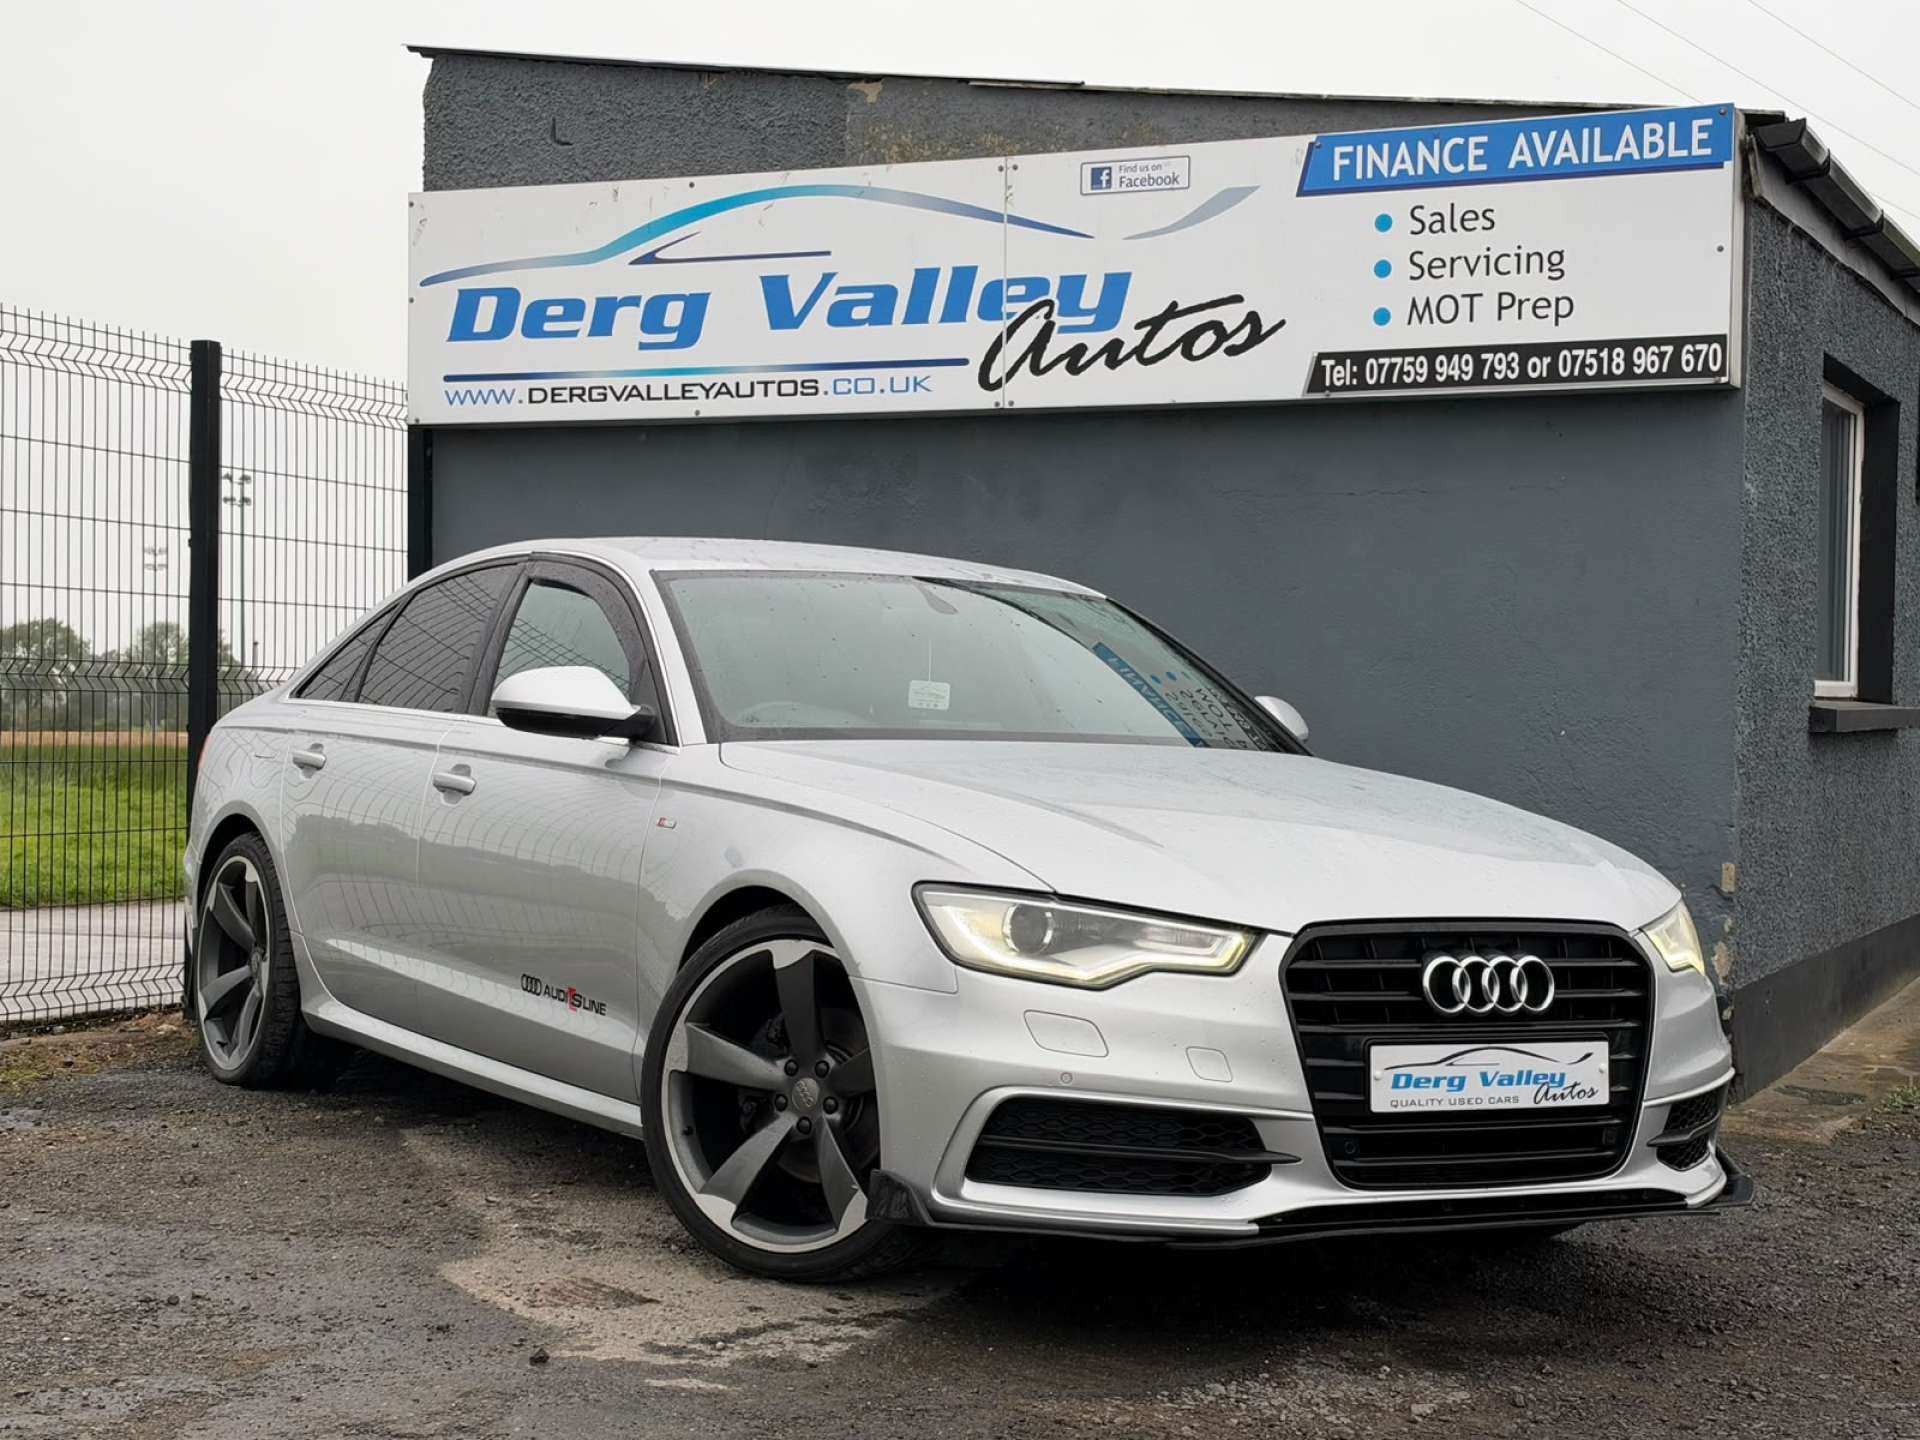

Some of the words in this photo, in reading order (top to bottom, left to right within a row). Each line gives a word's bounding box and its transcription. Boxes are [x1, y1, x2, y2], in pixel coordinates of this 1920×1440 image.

[1333, 136, 1488, 181] FINANCE
[1508, 119, 1713, 169] AVAILABLE
[1119, 165, 1137, 173] Find
[1152, 163, 1162, 171] on
[1119, 172, 1179, 187] Facebook
[1409, 203, 1495, 235] Sales
[1409, 245, 1565, 281] Servicing
[446, 286, 711, 351] Derg
[759, 265, 1132, 335] Valley
[1407, 293, 1483, 326] MOT
[1498, 291, 1574, 326] Prep
[978, 294, 1286, 392] Autos
[1321, 359, 1358, 387] Tel:
[1365, 355, 1427, 384] 07759
[1435, 353, 1473, 382] 949
[1481, 352, 1519, 380] 793
[1527, 355, 1551, 378] or
[1558, 347, 1624, 377] 07518
[1633, 345, 1673, 374] 967
[1681, 343, 1721, 372] 670
[543, 984, 568, 1003] AUDI
[1391, 1072, 1466, 1092] Derg
[1479, 1070, 1566, 1089] Valley
[1533, 1081, 1599, 1105] Autos
[1390, 1098, 1443, 1108] QUALITY
[1449, 1097, 1483, 1105] USED
[1488, 1096, 1519, 1104] CARS
